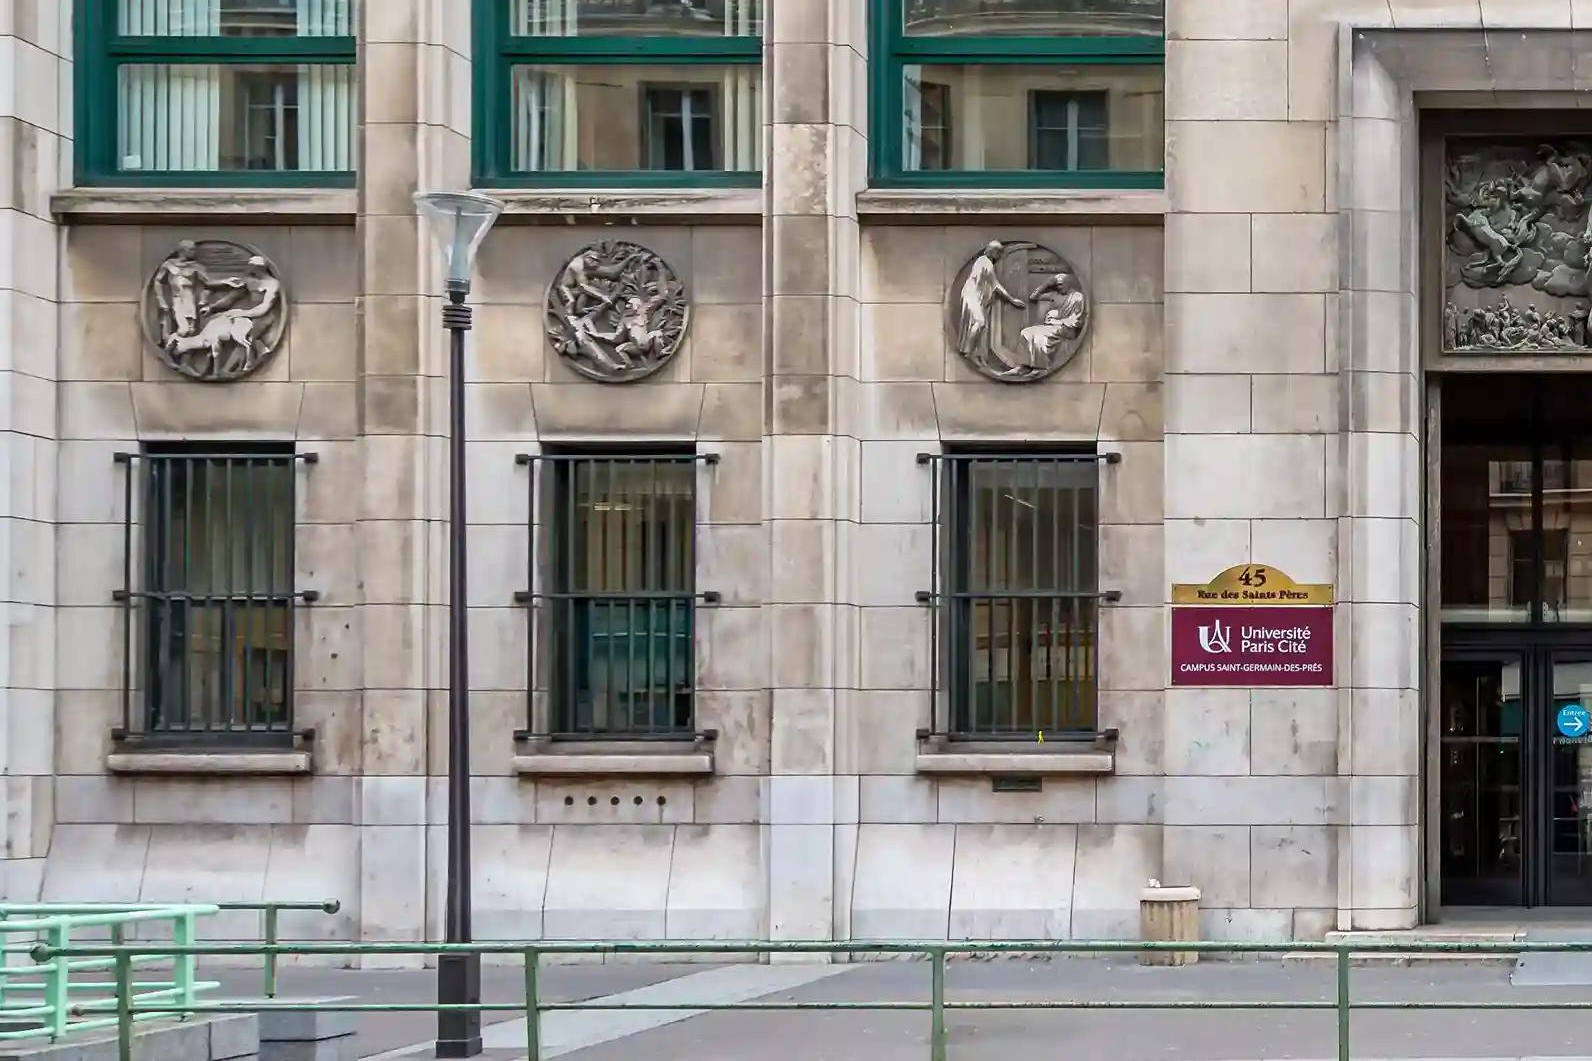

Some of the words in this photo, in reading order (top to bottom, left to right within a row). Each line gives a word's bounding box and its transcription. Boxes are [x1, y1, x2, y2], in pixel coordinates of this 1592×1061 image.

[1238, 567, 1267, 587] 45
[1197, 590, 1218, 600] Rue
[1221, 589, 1239, 600] des
[1242, 590, 1276, 600] Saints
[1279, 590, 1309, 600] Pères
[1241, 625, 1312, 640] Université
[1241, 640, 1275, 654] Paris
[1277, 639, 1307, 654] Cité
[1180, 663, 1216, 672] CAMPUS
[1216, 662, 1323, 672] SAINT-GERMAIN-DES-PRÉS
